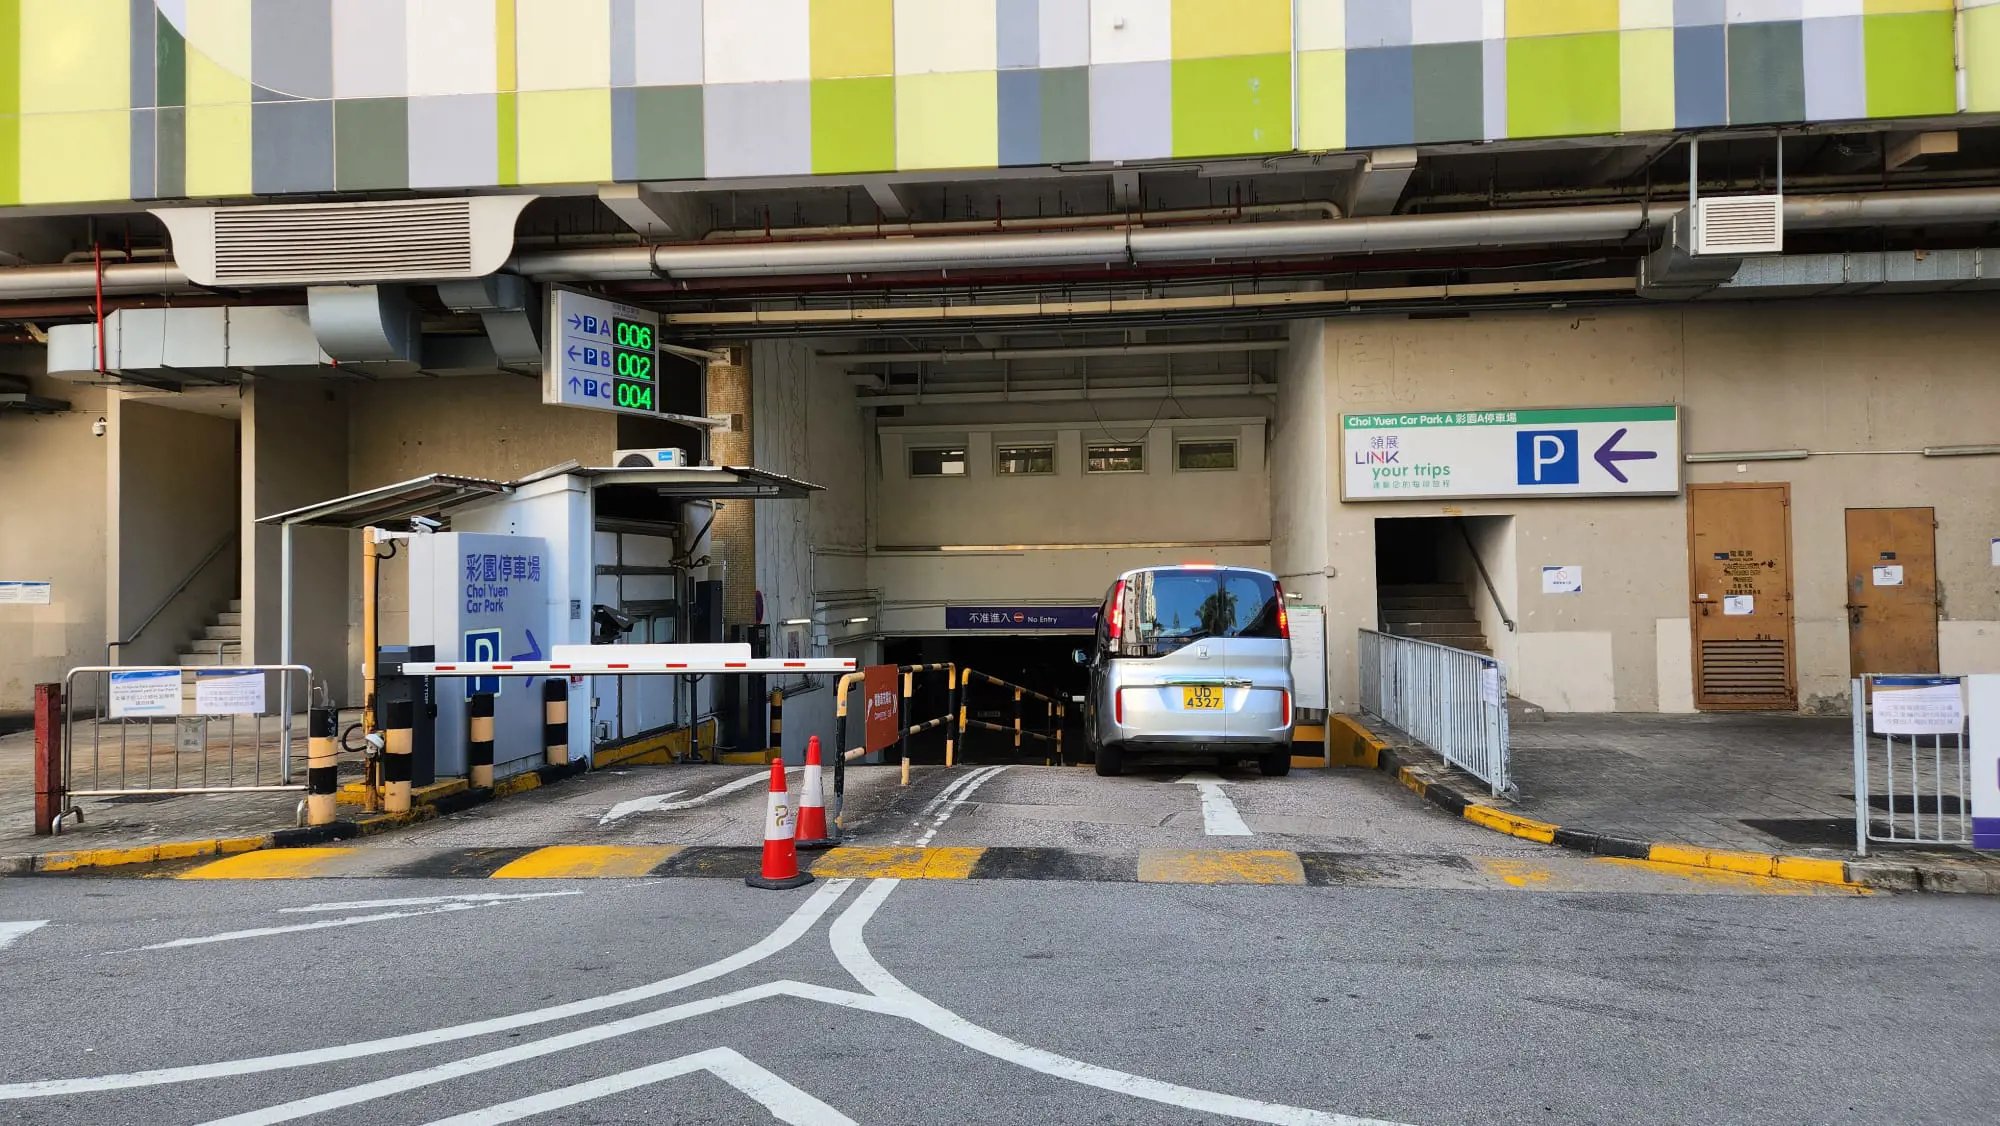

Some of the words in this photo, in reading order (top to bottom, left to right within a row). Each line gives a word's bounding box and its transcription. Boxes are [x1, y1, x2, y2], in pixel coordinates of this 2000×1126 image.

[587, 318, 595, 332] P
[599, 319, 611, 337] A
[617, 322, 651, 350] 006
[587, 350, 595, 363] P
[601, 351, 611, 368] B
[617, 352, 651, 380] 002
[587, 381, 595, 395] P
[600, 382, 611, 398] C
[617, 383, 651, 410] 004
[1349, 415, 1371, 426] Choi
[1374, 415, 1397, 426] Yuen
[1400, 415, 1418, 425] Car
[1420, 414, 1443, 425] Park
[1445, 414, 1453, 424] A
[1355, 451, 1400, 465] LINK
[1533, 435, 1566, 482] P
[1372, 466, 1408, 481] your
[1414, 463, 1451, 479] trips
[466, 554, 541, 583] 彩園停車場
[466, 584, 486, 599] Choi
[488, 584, 508, 598] Yuen
[466, 600, 482, 614] Car
[484, 599, 504, 613] Park
[968, 612, 1011, 624] 不准進入
[1039, 616, 1058, 625] Entry
[1194, 687, 1212, 698] UD
[1186, 697, 1220, 708] 4327
